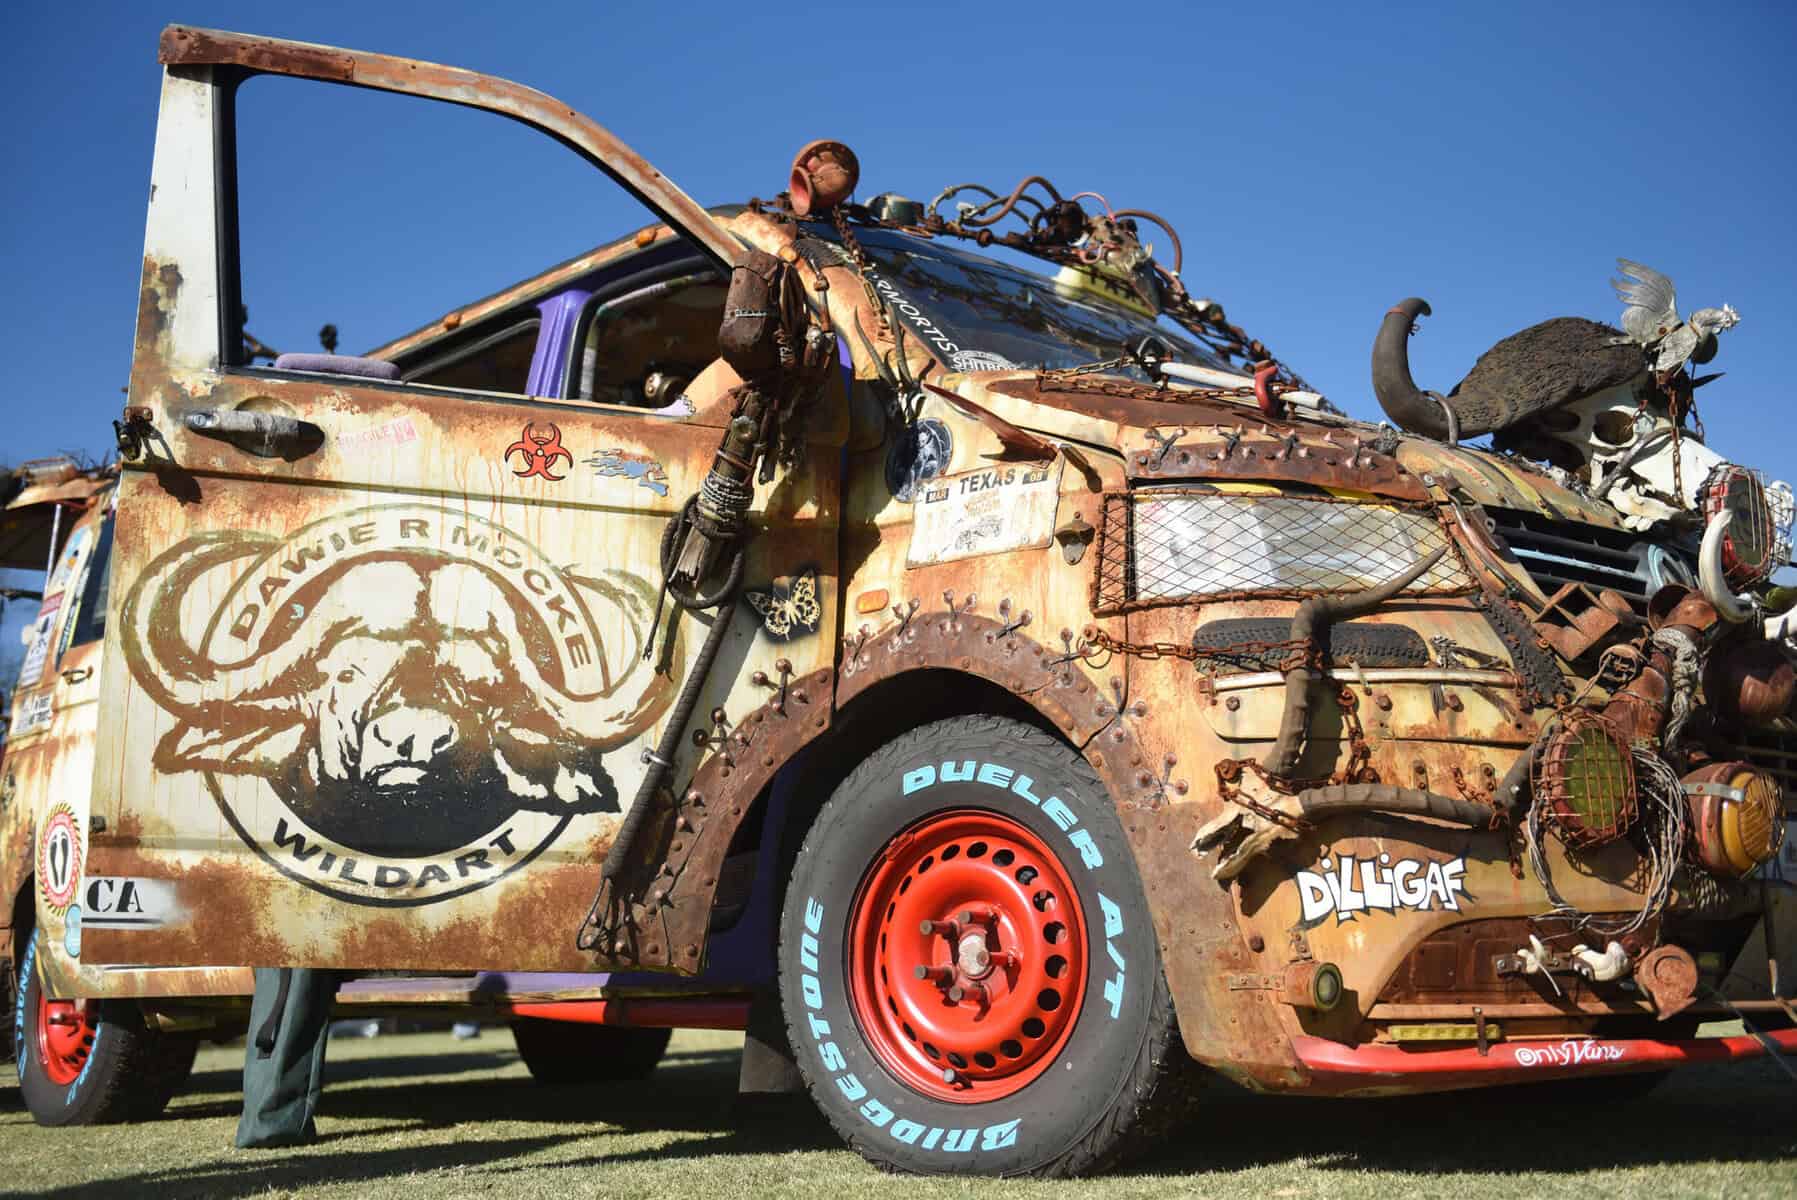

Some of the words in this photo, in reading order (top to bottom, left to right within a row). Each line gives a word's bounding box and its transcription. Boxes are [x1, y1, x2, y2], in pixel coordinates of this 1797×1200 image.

[959, 468, 1016, 495] TEXAS
[229, 521, 377, 642] DAWIE
[400, 518, 429, 539] R
[451, 524, 592, 669] MOCKE
[86, 879, 144, 913] CA
[273, 817, 516, 889] WILDART
[903, 760, 1103, 870] DUELER
[1097, 892, 1126, 1019] A/T
[801, 897, 1023, 1153] BRIDGESTONE
